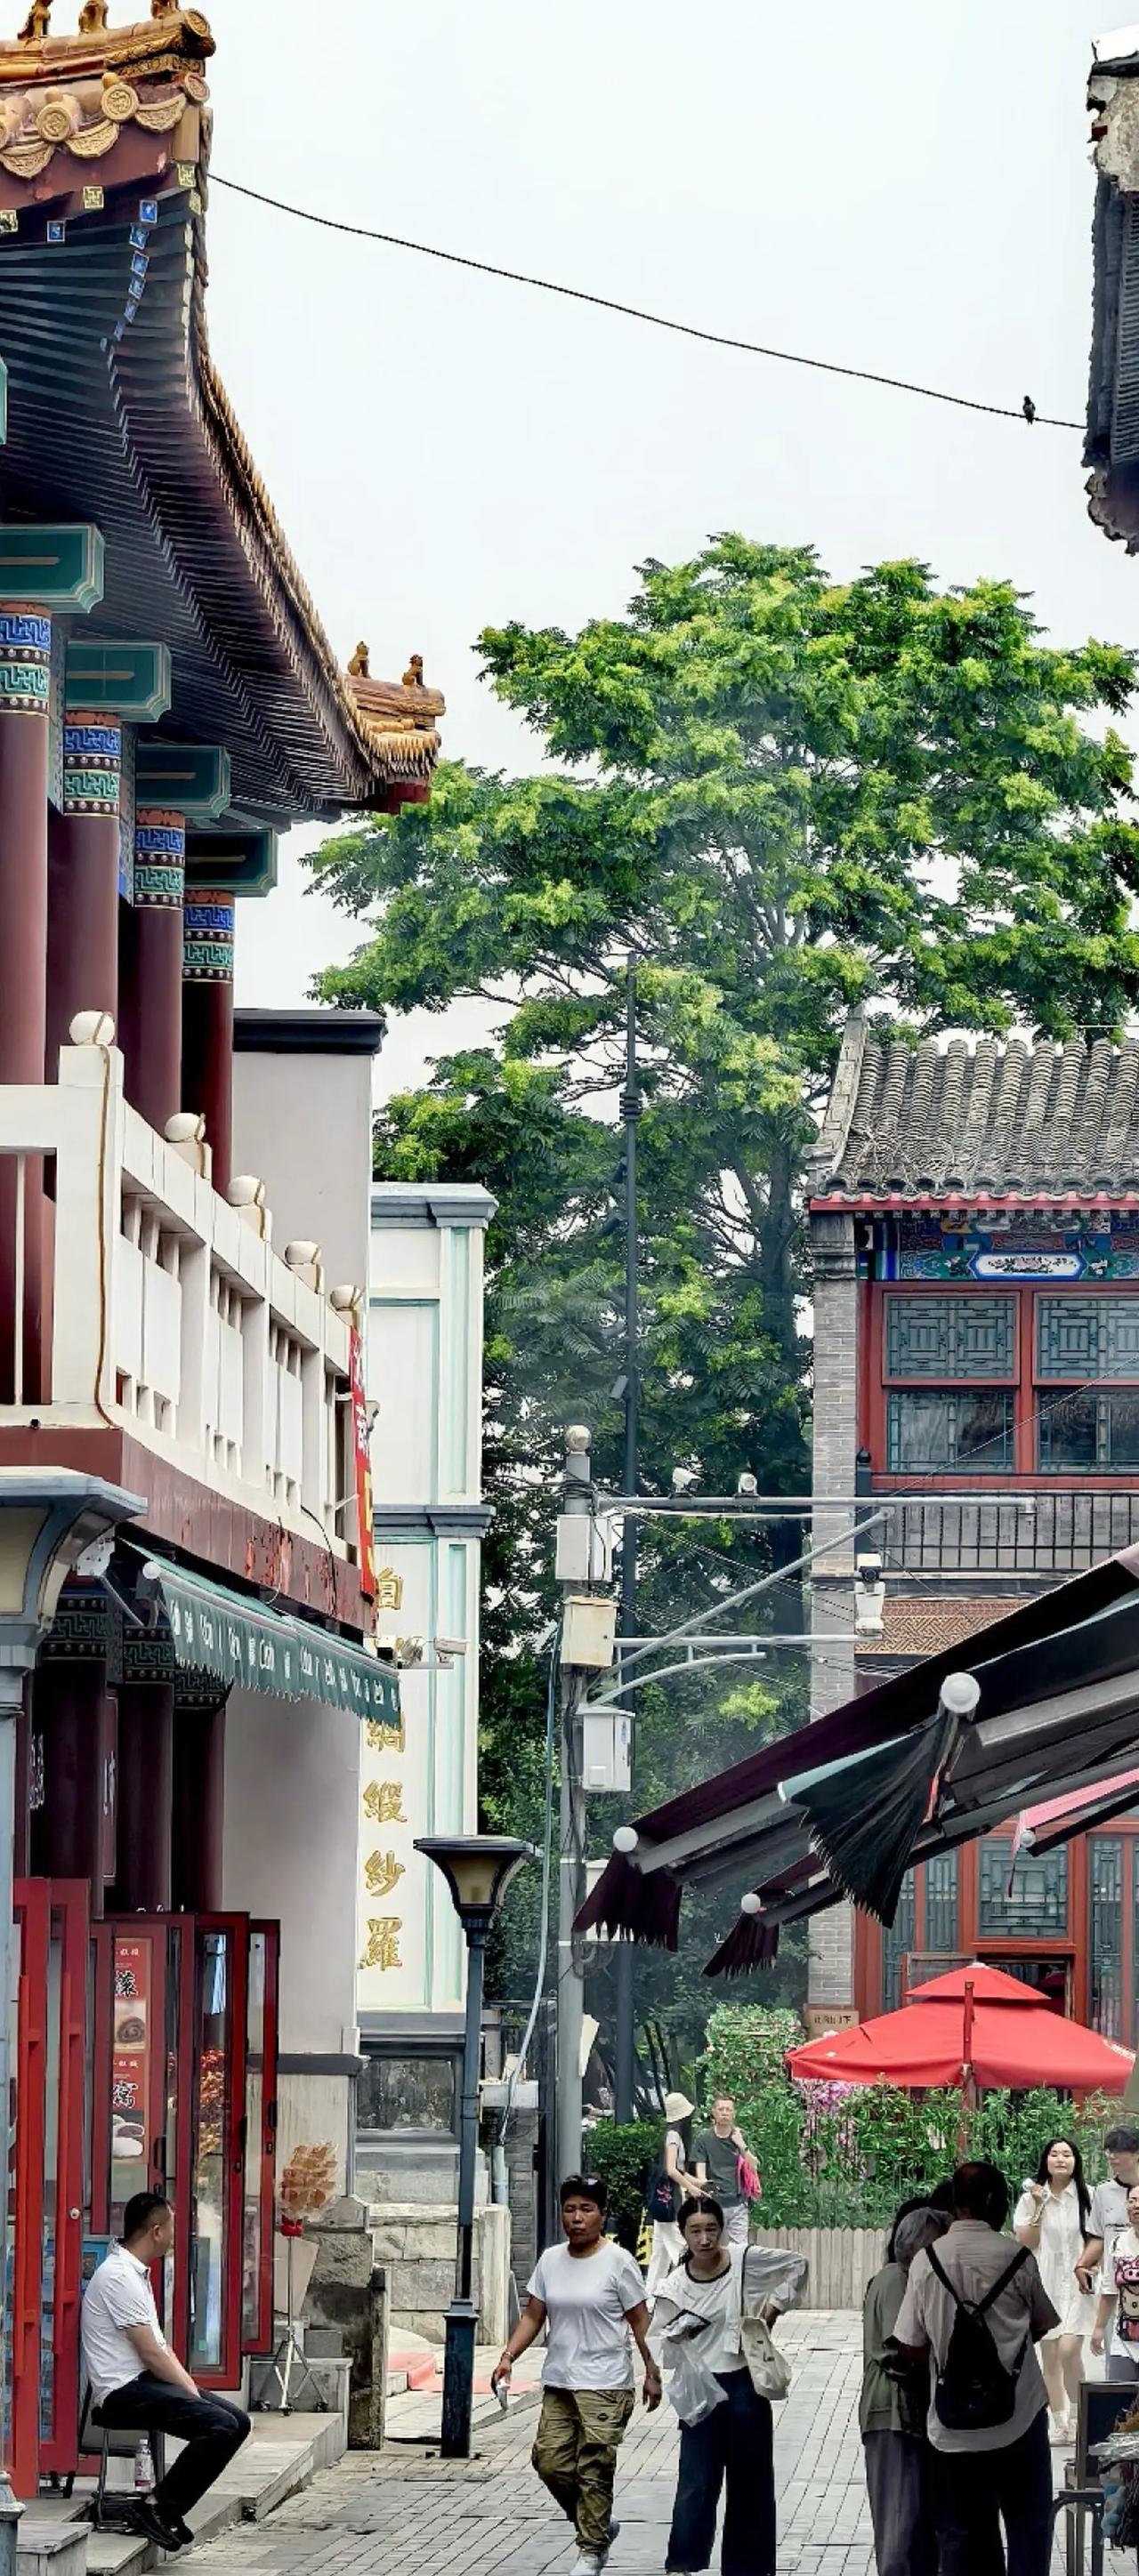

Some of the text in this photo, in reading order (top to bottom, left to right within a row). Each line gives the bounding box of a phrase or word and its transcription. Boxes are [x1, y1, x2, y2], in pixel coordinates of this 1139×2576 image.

[363, 1566, 408, 1971] 自綢緞紗羅
